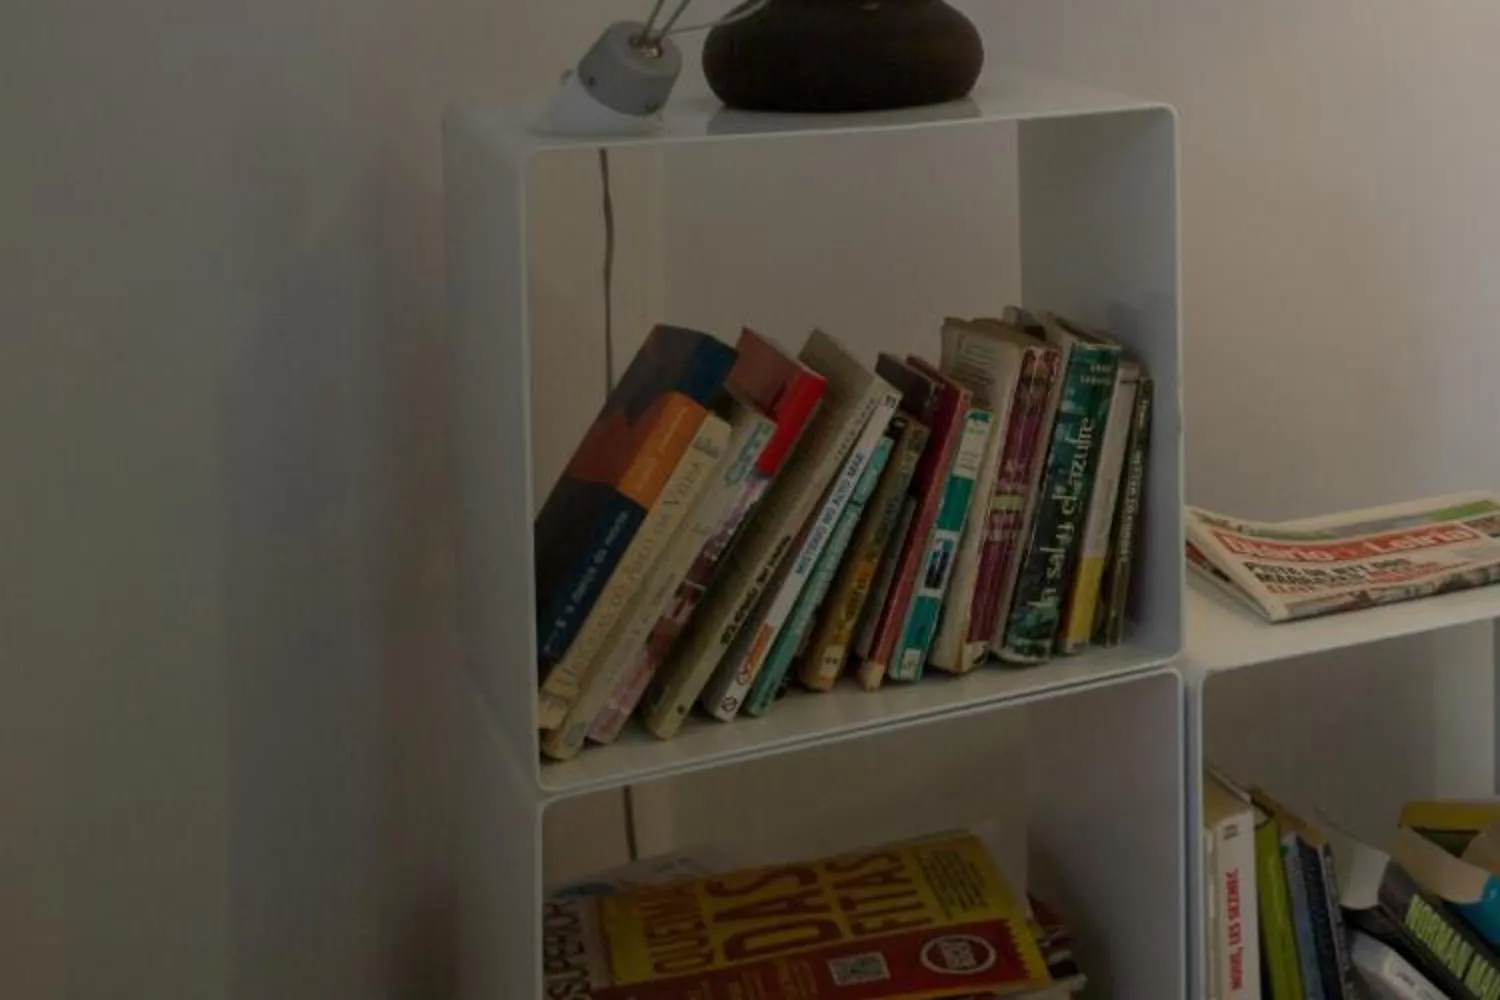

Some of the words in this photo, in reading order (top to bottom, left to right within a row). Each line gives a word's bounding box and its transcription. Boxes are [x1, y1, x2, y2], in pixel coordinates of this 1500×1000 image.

[705, 867, 843, 961] DAS
[824, 850, 933, 936] FITAS
[1404, 893, 1475, 979] NORMAN
